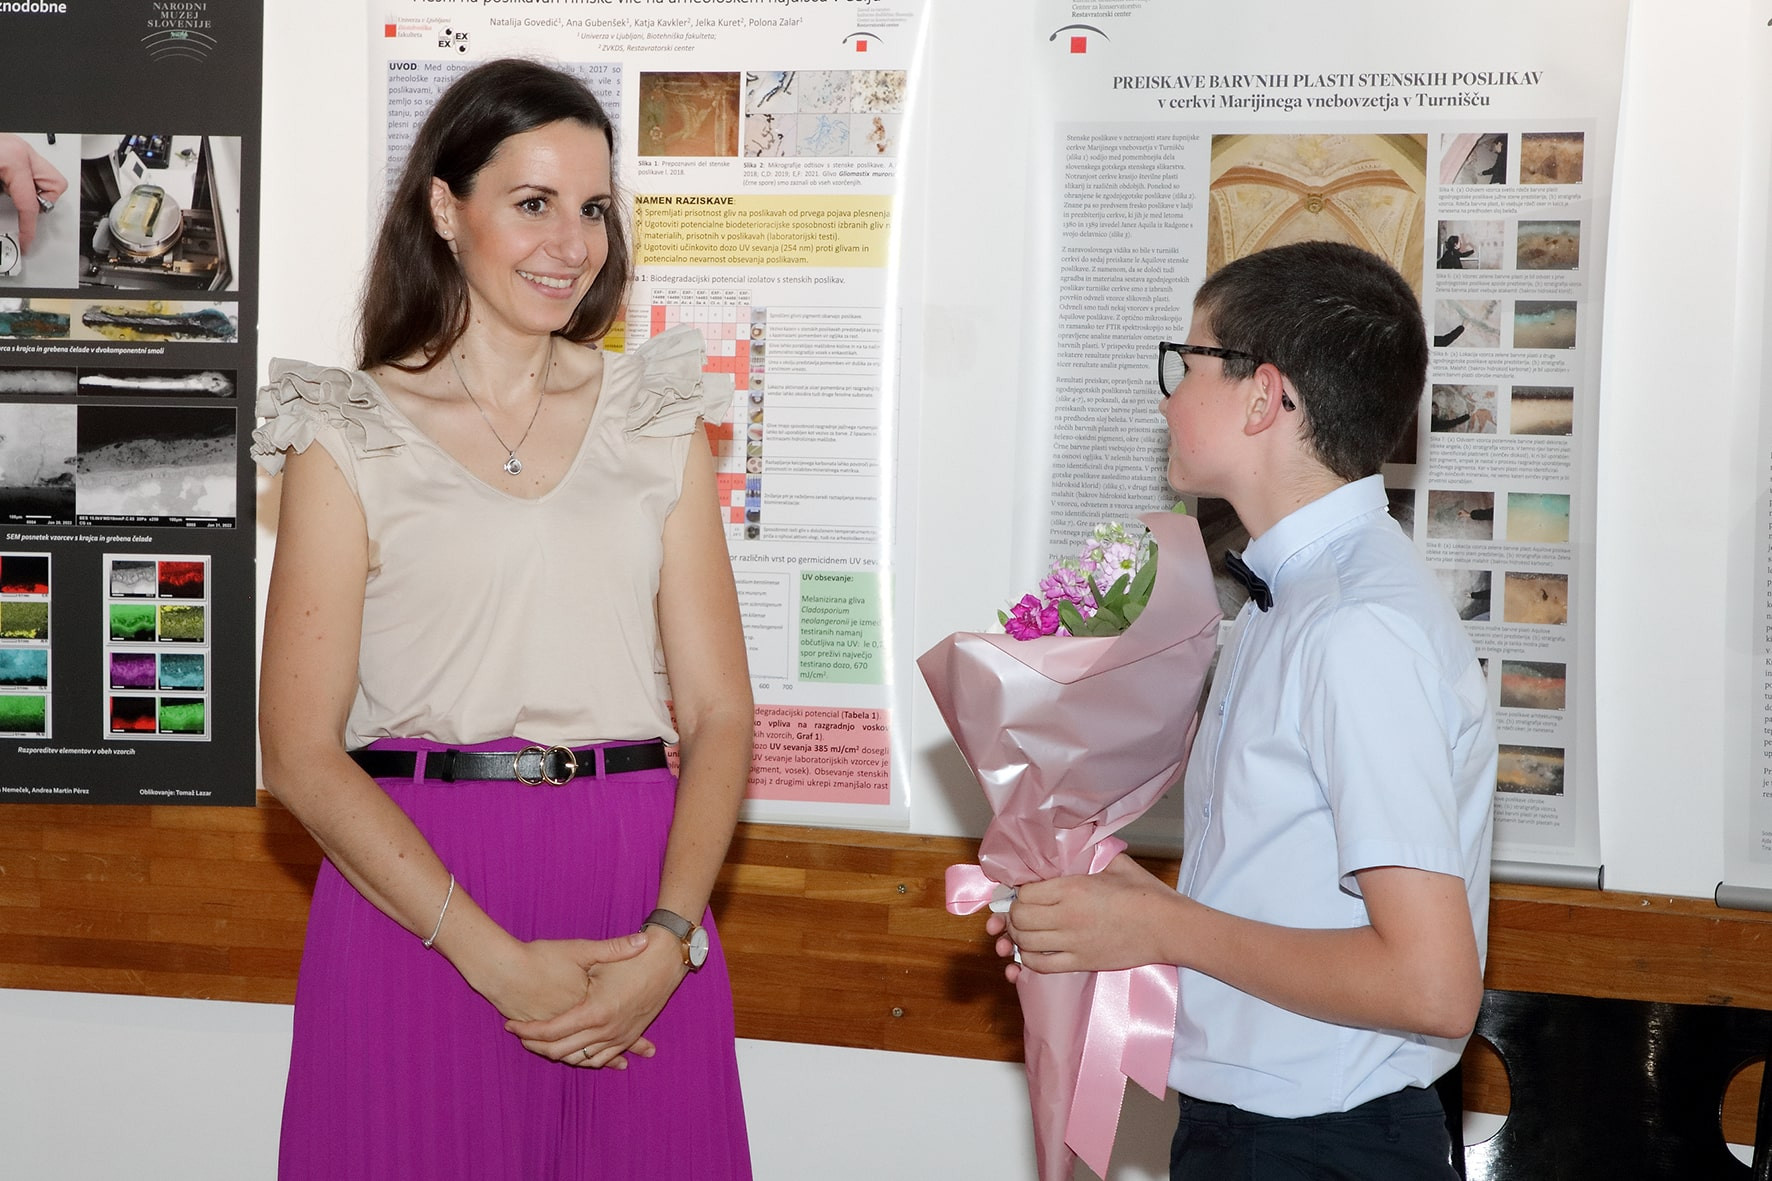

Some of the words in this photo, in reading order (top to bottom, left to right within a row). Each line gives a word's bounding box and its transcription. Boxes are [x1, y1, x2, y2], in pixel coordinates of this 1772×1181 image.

[153, 3, 206, 11] NARODNI
[161, 11, 198, 19] MUZEJ
[147, 20, 211, 28] SLOVENIJE
[1113, 76, 1205, 89] PREISKAVE
[1209, 75, 1288, 88] BARVNIH
[1293, 74, 1354, 87] PLASTI
[1358, 73, 1447, 86] STENSKIH
[1452, 72, 1543, 85] POSLIKAV
[1169, 95, 1215, 108] cerkvi
[1220, 94, 1302, 112] Marijinega
[1306, 94, 1399, 111] vnebovzetja
[1415, 92, 1490, 106] Turnišču
[645, 209, 683, 218] Spremljati
[723, 209, 737, 218] gliv
[749, 209, 787, 218] poslikavah
[788, 209, 799, 217] od
[644, 221, 679, 229] Ugotoviti
[680, 221, 724, 229] potencialne
[725, 221, 790, 229] biodeterioracijske
[792, 221, 836, 229] sposobnosti
[837, 221, 868, 229] izbranih
[869, 221, 883, 231] gliv
[643, 232, 685, 240] materialih,
[726, 233, 765, 241] poslikavah
[766, 233, 817, 241] (laboratorijski
[643, 244, 678, 252] Ugotoviti
[751, 245, 779, 253] sevanja
[780, 244, 797, 253] (254
[798, 244, 814, 253] nm)
[815, 245, 833, 253] proti
[834, 245, 860, 253] glivam
[650, 275, 710, 284] Biodegradacijski
[711, 276, 746, 284] potencial
[814, 276, 845, 284] poslikav.
[814, 575, 853, 583] obsevanje:
[801, 595, 847, 603] Melanizirana
[848, 597, 865, 605] gliva
[801, 606, 850, 615] Cladosporium
[800, 639, 835, 647] občutljiva
[863, 640, 870, 648] le
[842, 651, 872, 660] največjo
[832, 661, 852, 669] dozo,
[755, 708, 803, 717] degradacijski
[841, 711, 869, 719] (Tabela
[768, 720, 791, 728] vpliva
[814, 722, 855, 731] razgradnjo
[766, 732, 794, 740] vzorcih,
[796, 732, 813, 740] Graf
[783, 744, 812, 753] sevanja
[764, 755, 793, 764] sevanje
[794, 756, 849, 765] laboratorijskih
[881, 759, 888, 767] je
